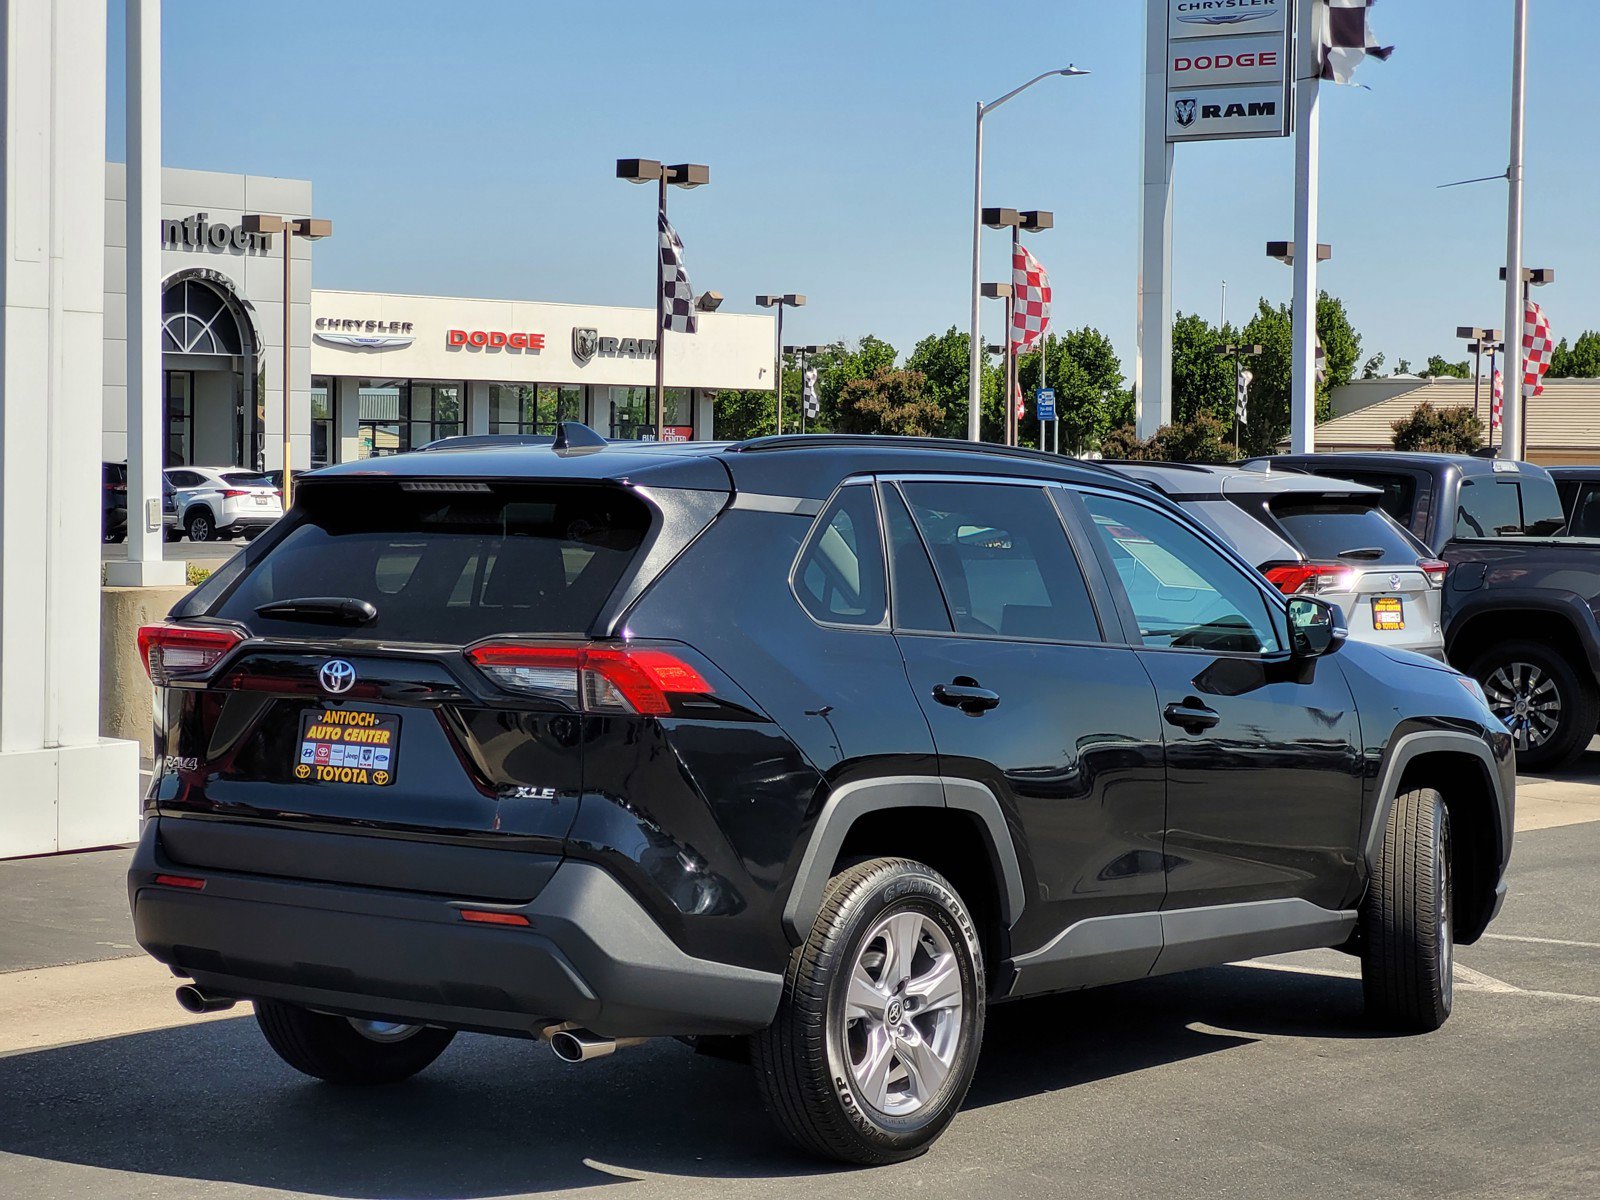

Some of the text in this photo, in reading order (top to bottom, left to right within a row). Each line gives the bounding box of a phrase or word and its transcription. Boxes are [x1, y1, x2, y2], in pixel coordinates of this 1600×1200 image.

[1177, 0, 1275, 11] CHRYSLER
[1174, 52, 1277, 71] DODGE
[1202, 102, 1275, 118] RAM
[315, 318, 413, 332] CHRYSLER
[448, 329, 545, 350] DODGE
[322, 710, 375, 726] ANTIOCH
[306, 726, 390, 744] AUTO CENTER
[164, 756, 198, 770] RAV4
[317, 766, 368, 784] TOYOTA
[515, 787, 555, 799] XLE
